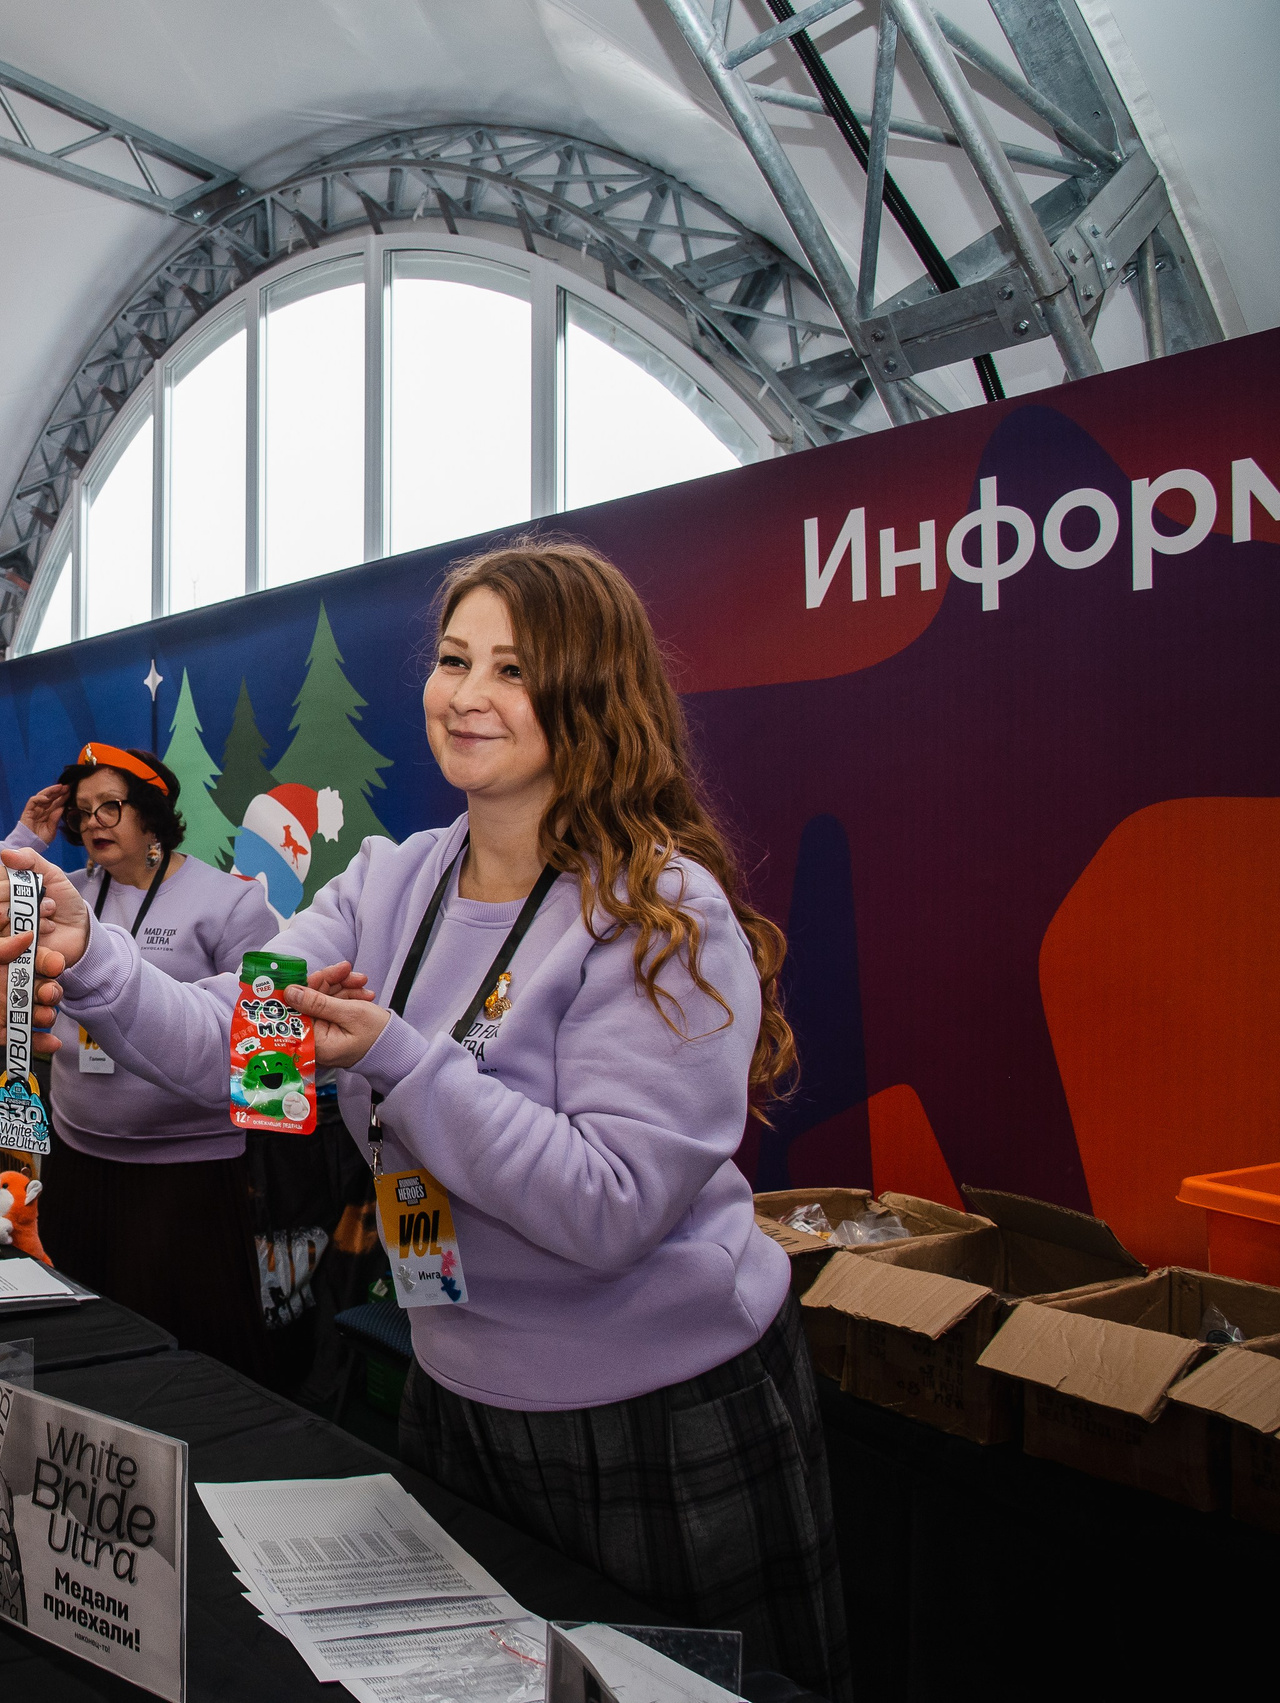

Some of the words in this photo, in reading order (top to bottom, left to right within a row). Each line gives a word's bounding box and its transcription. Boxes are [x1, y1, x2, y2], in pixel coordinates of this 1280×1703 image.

[146, 937, 170, 945] ULTRA
[256, 985, 272, 993] FREE
[12, 1012, 26, 1023] RHR
[463, 1040, 486, 1062] TRA
[0, 1121, 32, 1137] White
[397, 1185, 425, 1202] HEROES
[399, 1210, 442, 1259] VOL
[418, 1271, 441, 1281] Инга
[46, 1422, 137, 1488] White
[31, 1457, 156, 1548] Bride
[47, 1512, 136, 1584] Ultra
[54, 1566, 129, 1623] Медали
[43, 1592, 140, 1653] приехали!
